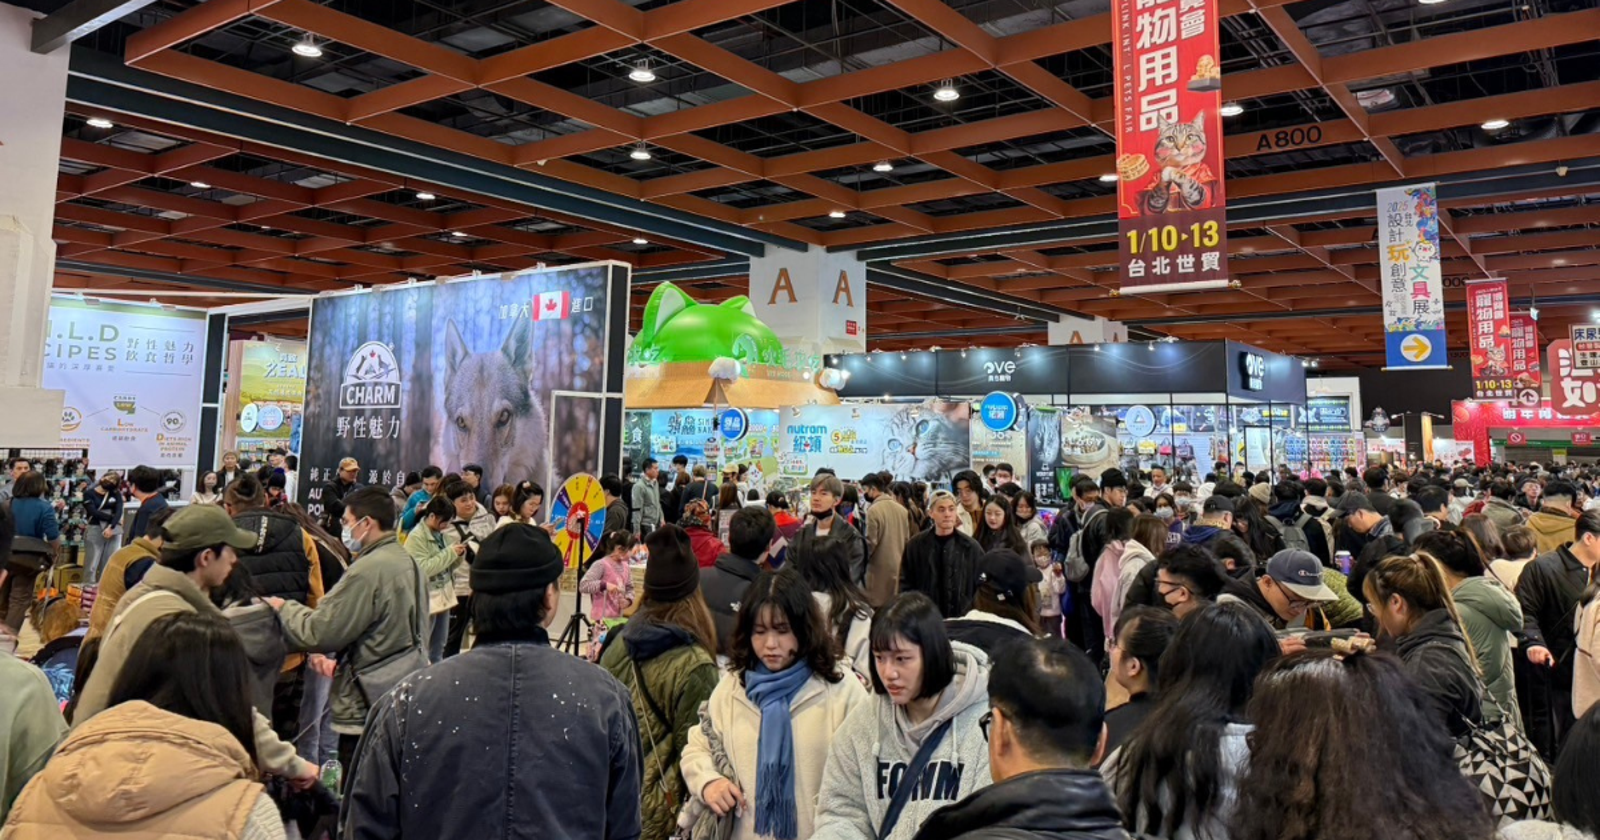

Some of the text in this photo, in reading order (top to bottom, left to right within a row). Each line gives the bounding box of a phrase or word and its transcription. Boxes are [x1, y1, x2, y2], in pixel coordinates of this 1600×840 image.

[1136, 0, 1179, 132] 物用品
[1256, 125, 1322, 152] A800
[1387, 201, 1409, 213] 2025
[1127, 251, 1220, 278] 台北世貿
[768, 267, 798, 306] A
[833, 269, 854, 308] A
[1409, 263, 1431, 314] 文具展
[499, 301, 530, 320] 加拿大
[571, 296, 594, 313] 進口
[125, 337, 194, 353] 野性魅力
[125, 349, 194, 366] 飲食哲學
[346, 384, 396, 406] CHARM
[335, 415, 401, 440] 野性魅力
[786, 424, 828, 435] nutram
